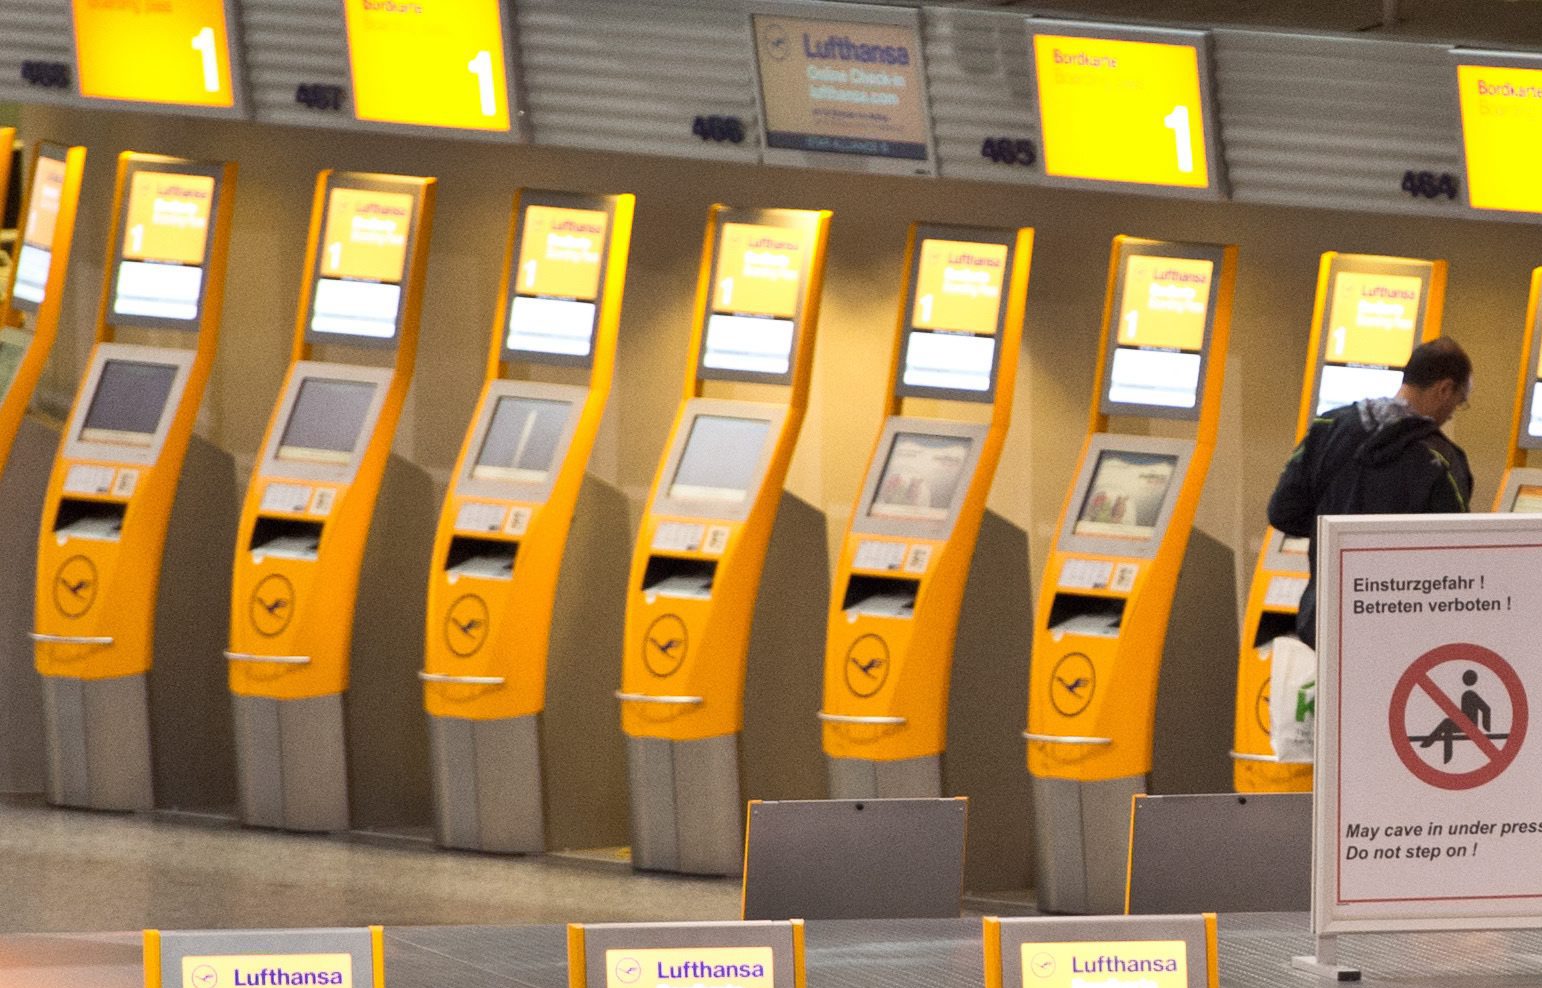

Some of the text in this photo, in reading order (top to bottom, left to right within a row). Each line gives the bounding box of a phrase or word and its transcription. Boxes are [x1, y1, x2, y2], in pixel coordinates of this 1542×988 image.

[192, 27, 219, 92] 1
[803, 32, 909, 65] Lufthansa
[468, 50, 496, 116] 1
[1477, 80, 1542, 98] Bordkarte
[982, 137, 1037, 166] 465
[1164, 105, 1193, 173] 1
[1402, 170, 1458, 199] 464
[1123, 310, 1138, 339] 1
[1332, 326, 1346, 355] 1
[1353, 575, 1485, 594] Einsturzgefahr !
[1353, 596, 1512, 614] Betreten verboten !
[1346, 823, 1380, 841] May
[1384, 825, 1424, 837] cave
[1428, 821, 1443, 836] in
[1449, 820, 1497, 835] under
[1346, 843, 1478, 862] Do not step on !
[234, 968, 343, 987] Lufthansa
[657, 961, 764, 979] Lufthansa
[1072, 956, 1178, 974] Lufthansa
